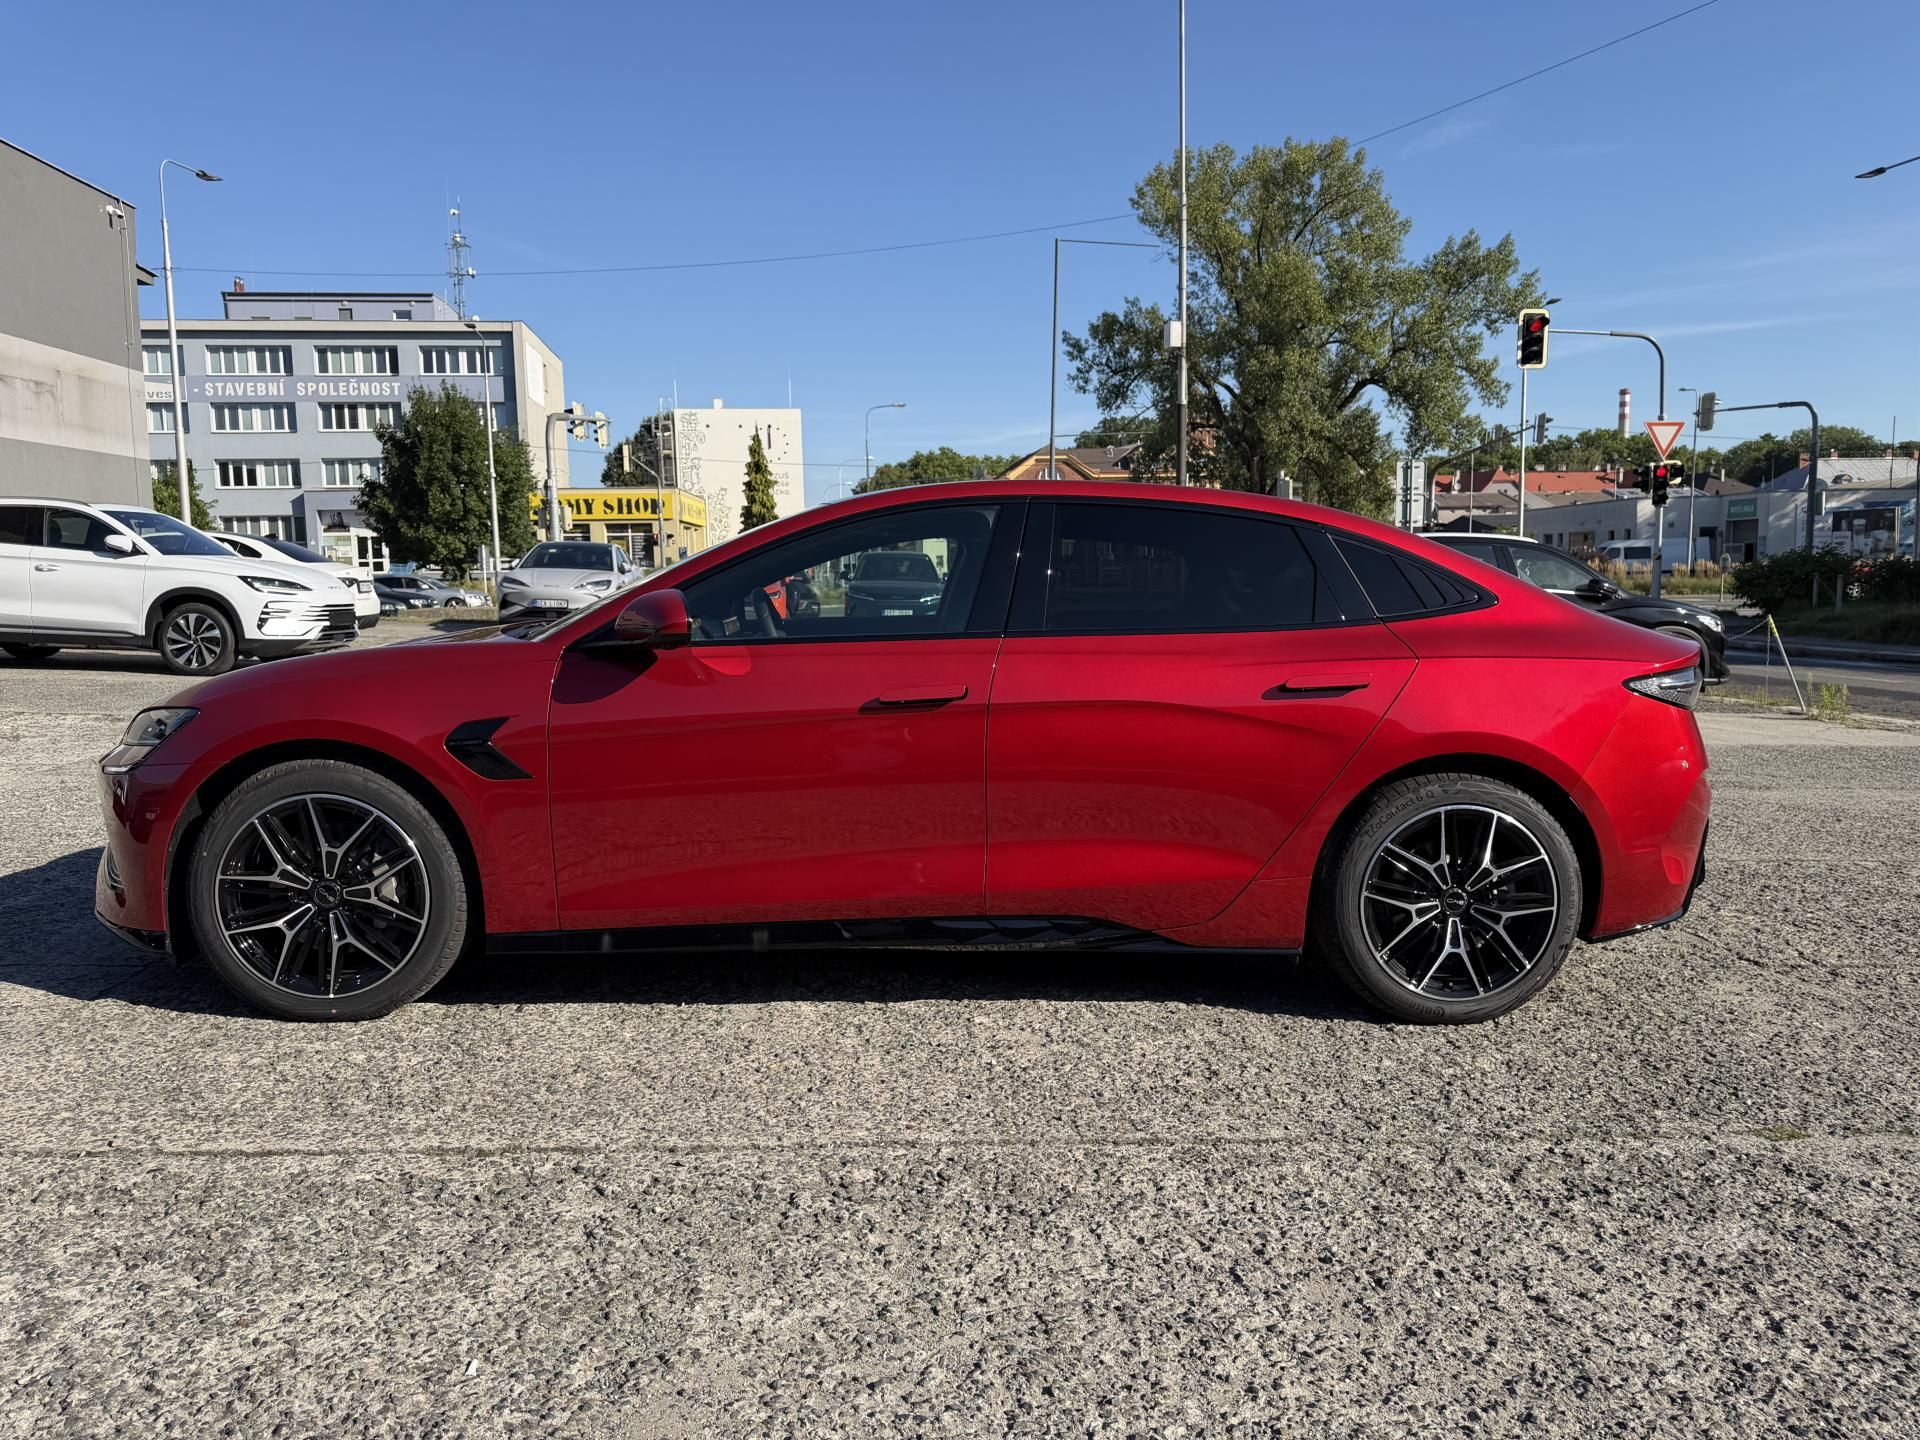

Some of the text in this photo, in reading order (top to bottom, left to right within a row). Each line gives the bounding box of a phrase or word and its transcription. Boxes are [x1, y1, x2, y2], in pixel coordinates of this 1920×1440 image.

[205, 378, 285, 397] STAVEBNÍ
[296, 378, 401, 397] SPOLEČNOST
[1415, 794, 1424, 802] 6
[1425, 789, 1436, 799] Q
